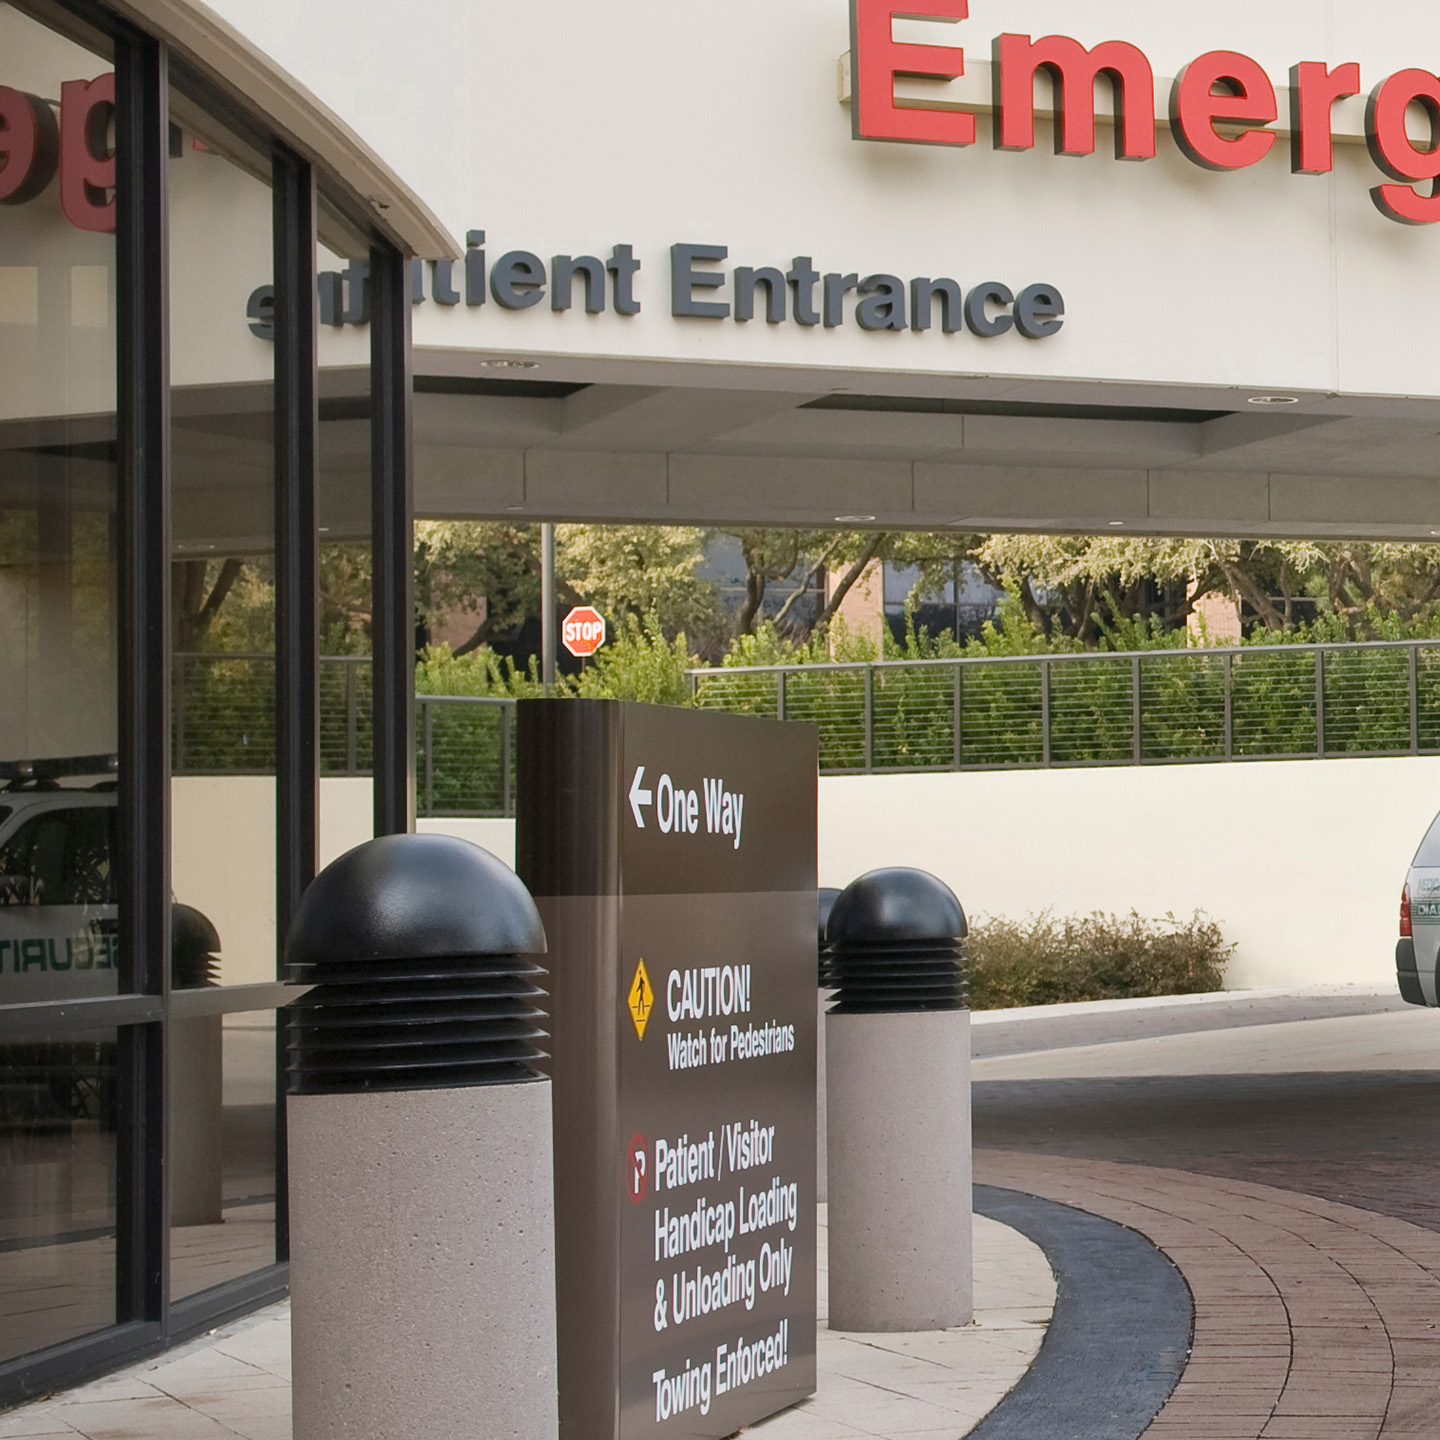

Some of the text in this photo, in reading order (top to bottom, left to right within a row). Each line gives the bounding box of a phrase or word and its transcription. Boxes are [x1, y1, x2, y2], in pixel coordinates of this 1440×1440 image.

[411, 229, 642, 317] tient
[670, 243, 1066, 340] Entrance
[565, 621, 602, 642] STOP
[656, 773, 744, 850] One Way
[666, 964, 751, 1022] CAUTION!
[667, 1019, 795, 1070] Watch for Pedestrians
[655, 1130, 715, 1192] Patient
[655, 1176, 798, 1262] Handicap Loading
[653, 1237, 793, 1332] & Unloading Only
[652, 1318, 788, 1422] Towing Enforced!
